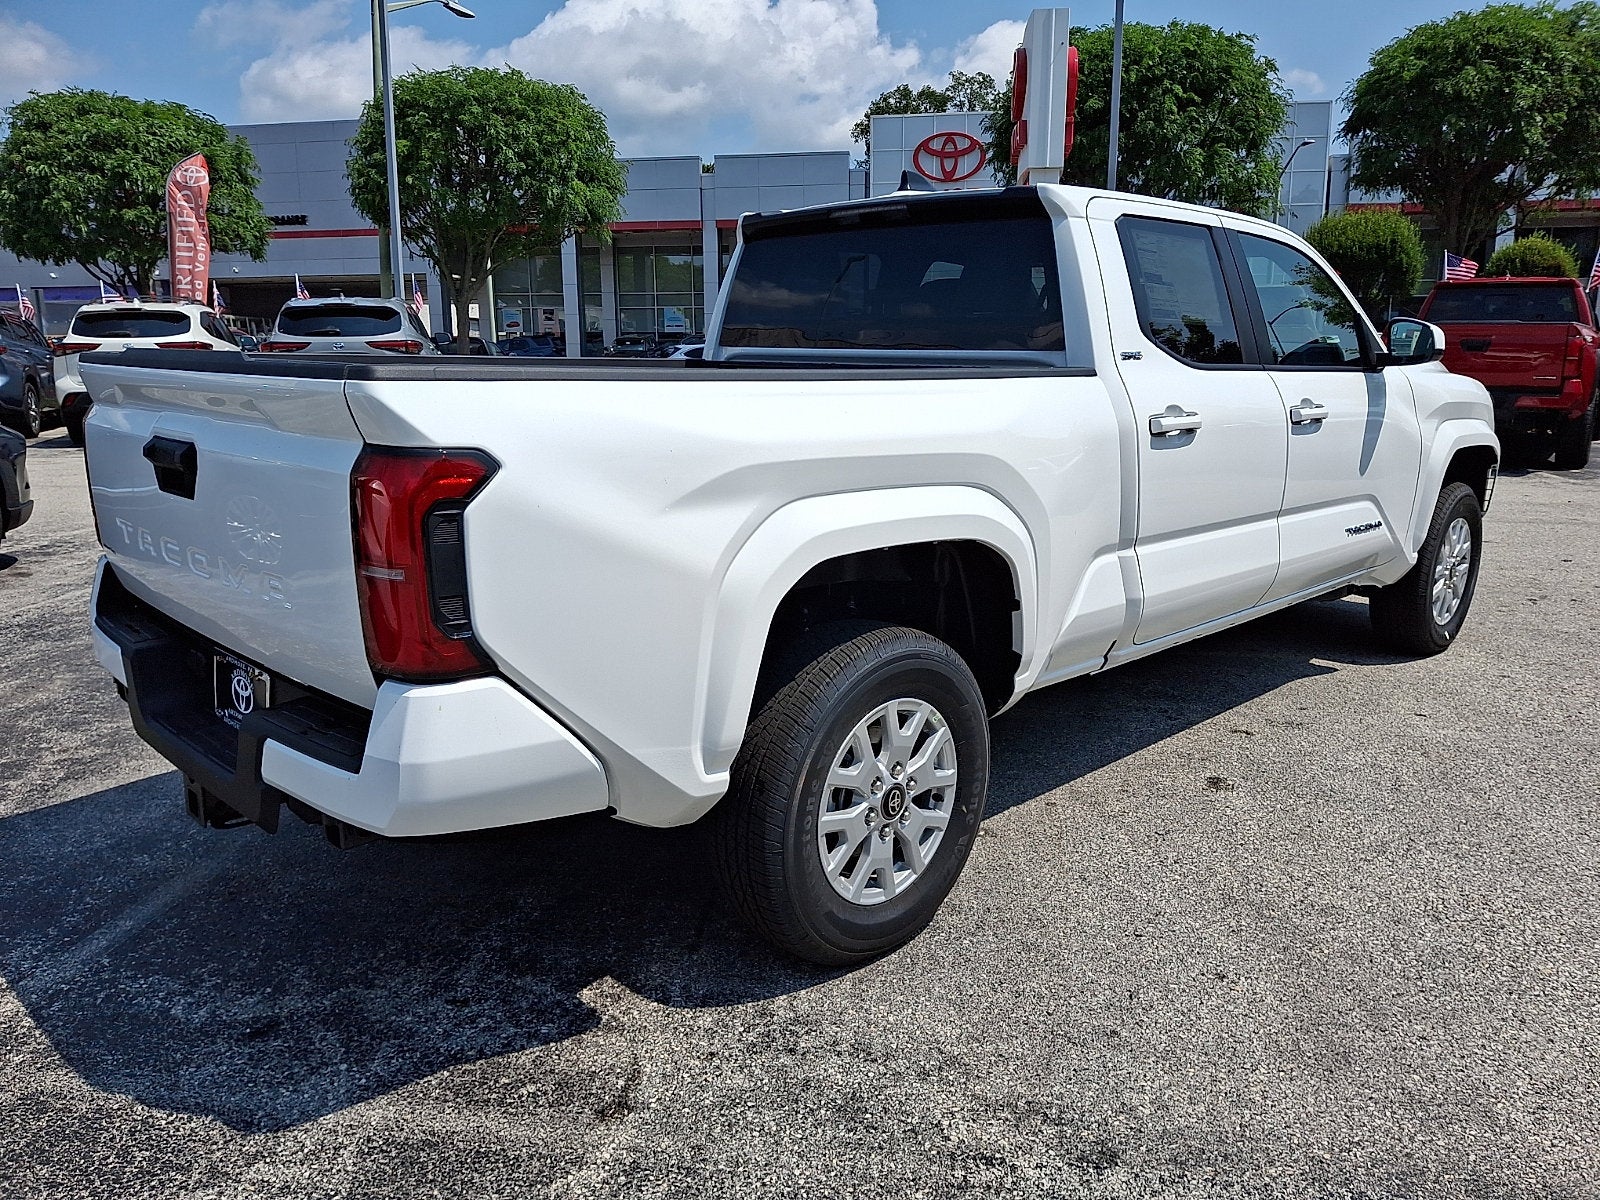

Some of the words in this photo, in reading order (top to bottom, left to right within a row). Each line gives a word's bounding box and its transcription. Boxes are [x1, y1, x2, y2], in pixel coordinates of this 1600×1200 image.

[176, 190, 196, 298] RTIFIED
[194, 280, 203, 300] ed
[116, 516, 293, 610] TACOMA
